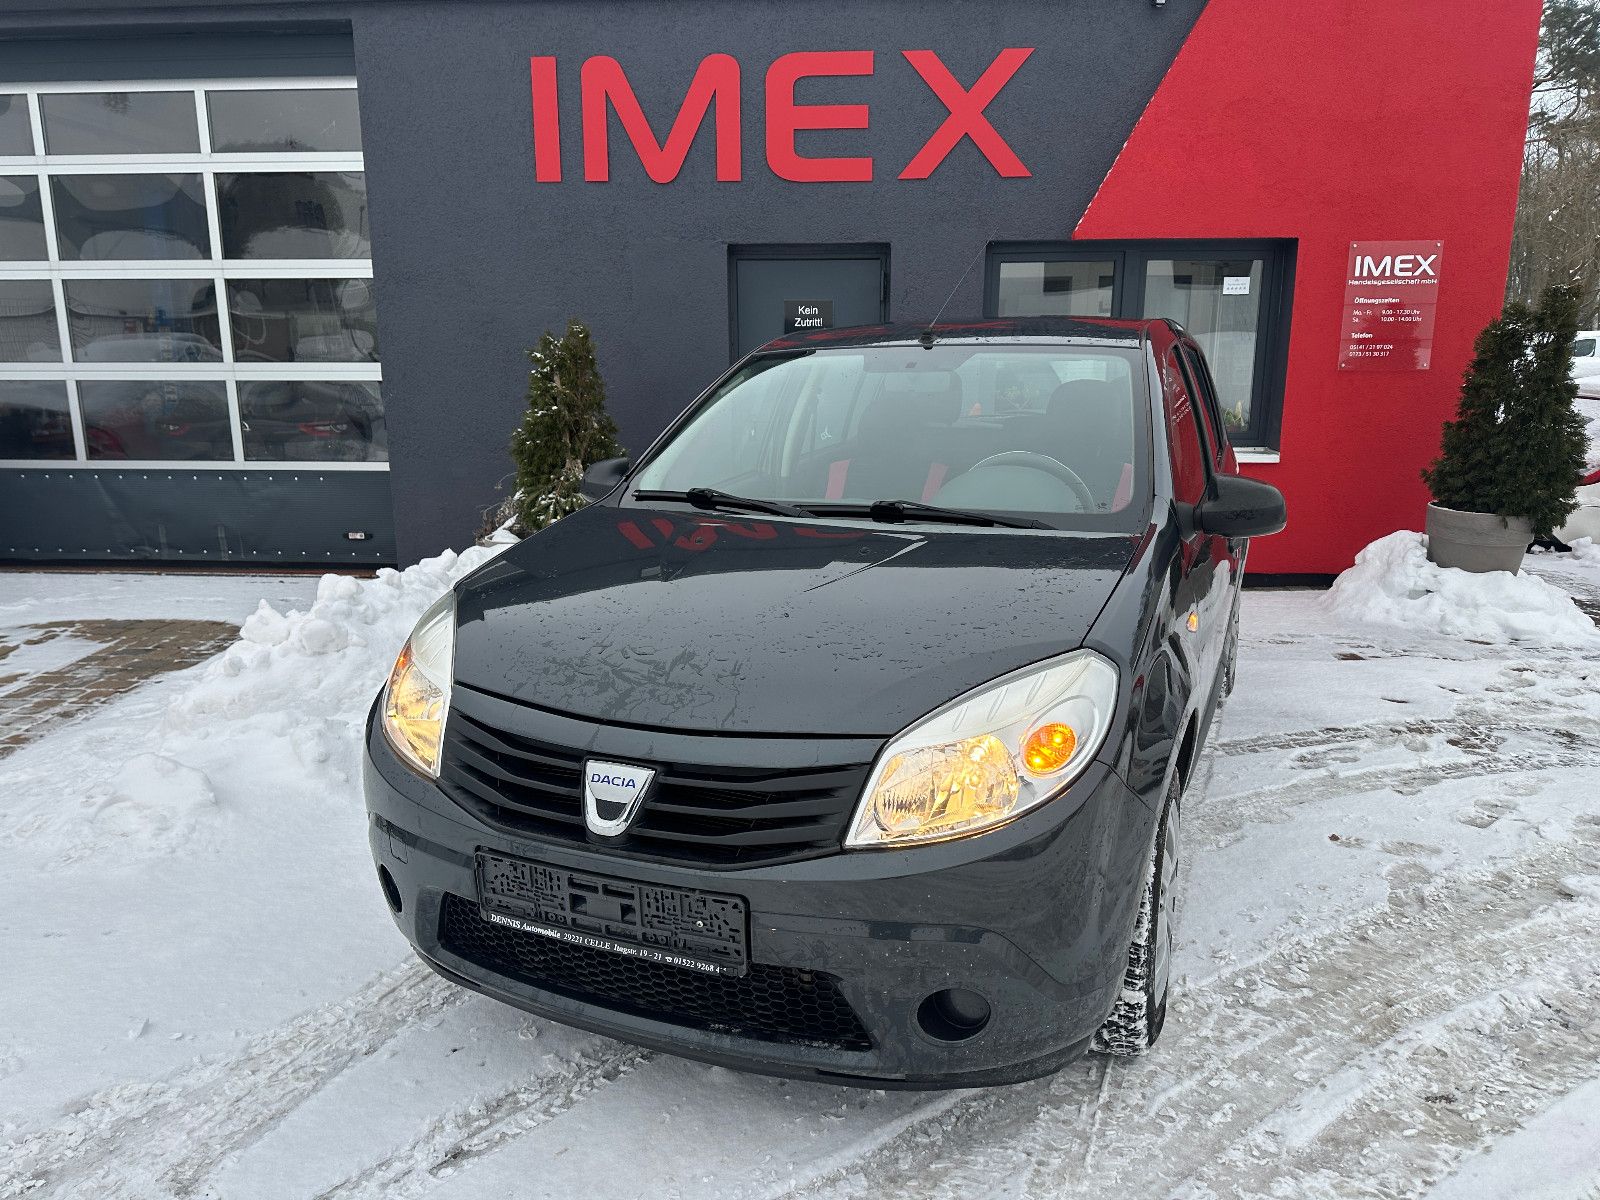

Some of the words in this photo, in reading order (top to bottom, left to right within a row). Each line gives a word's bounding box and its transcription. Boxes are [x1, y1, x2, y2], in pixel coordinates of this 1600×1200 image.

[530, 47, 1035, 184] IMEX
[1354, 254, 1438, 277] IMEX
[1348, 278, 1420, 287] Handelsgesellschaft
[1354, 296, 1400, 304] Öffnungszeiten
[798, 305, 819, 315] Kein
[794, 317, 823, 327] Zutritt!
[590, 773, 636, 789] DACIA
[490, 913, 521, 929] DENNIS
[521, 922, 561, 939] Automobile
[563, 932, 583, 944] 29221
[584, 937, 611, 950] CELLE
[639, 949, 648, 957] 19
[653, 952, 662, 960] 21
[673, 956, 695, 968] 01522
